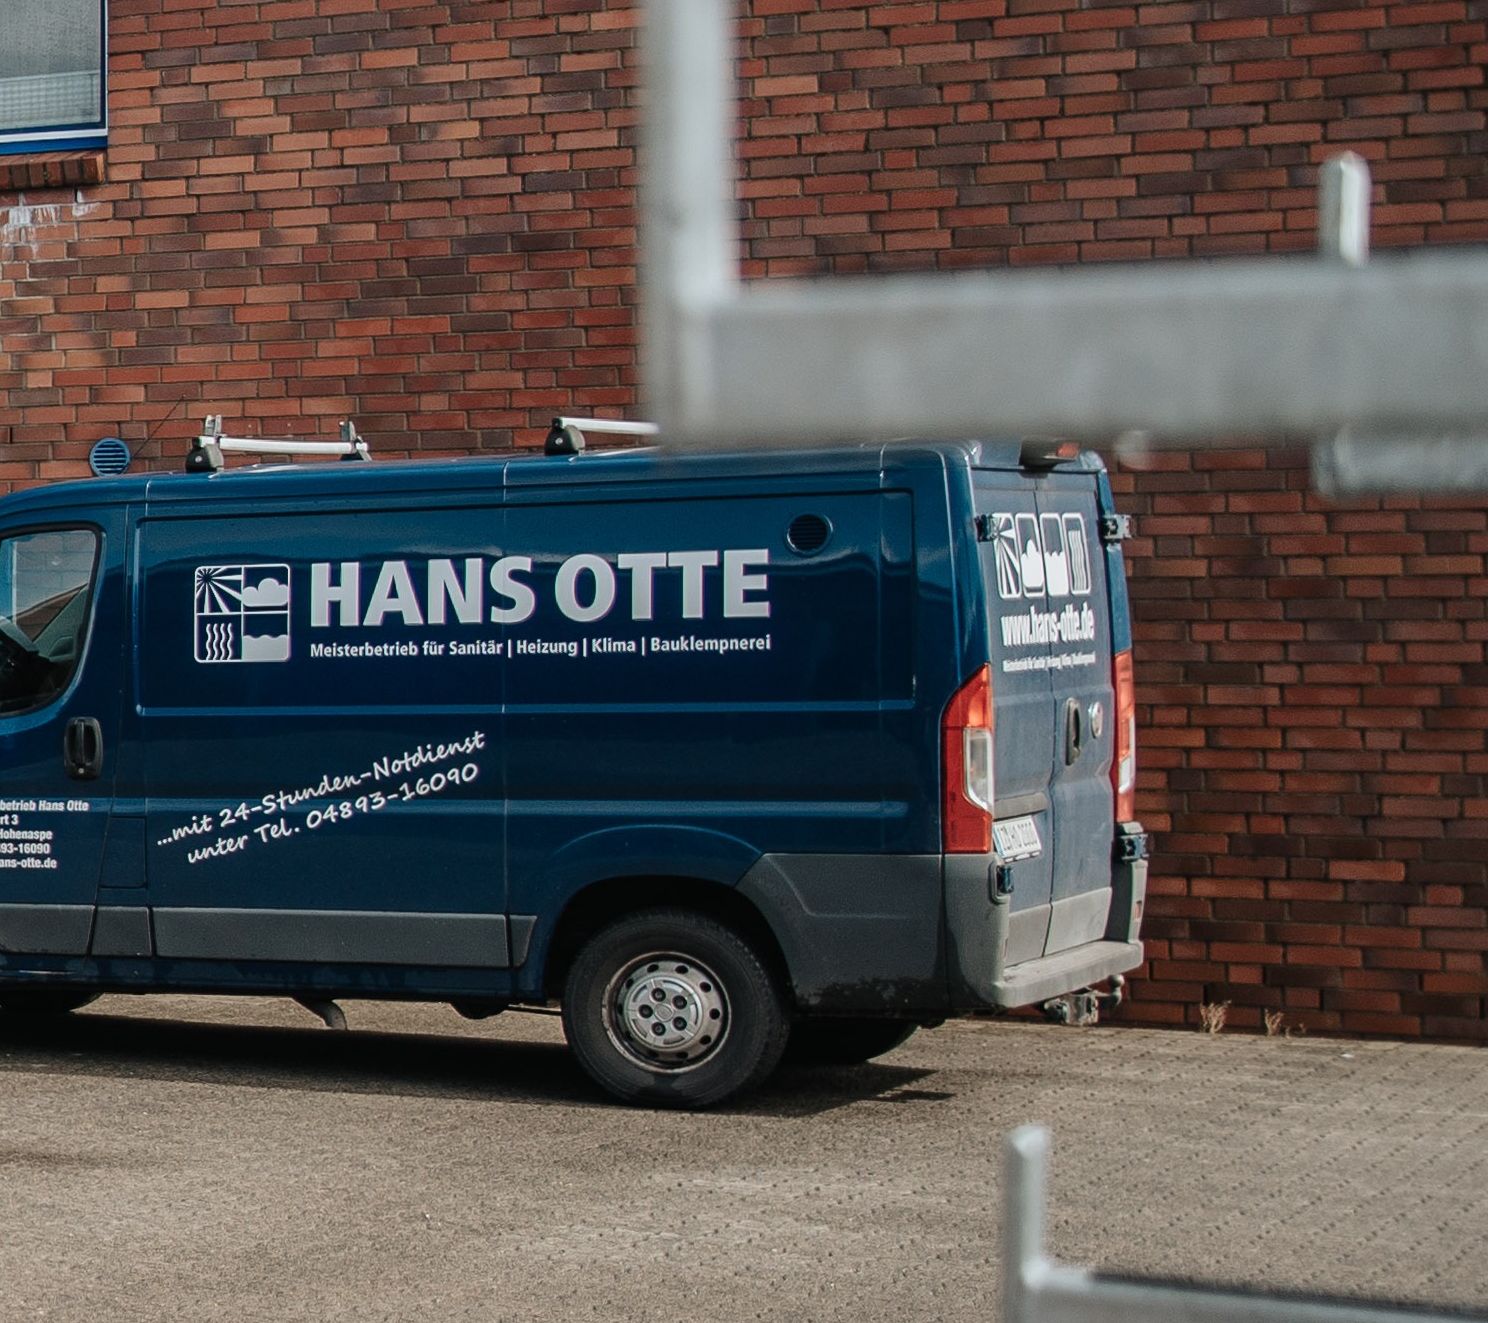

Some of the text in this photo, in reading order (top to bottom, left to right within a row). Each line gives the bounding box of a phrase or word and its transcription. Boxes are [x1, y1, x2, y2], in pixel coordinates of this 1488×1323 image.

[311, 549, 770, 627] HANS OTTE
[311, 642, 418, 657] Meisterbetrieb
[423, 641, 444, 655] für
[450, 640, 502, 654] Sanitär
[517, 639, 577, 656] Heizung
[593, 638, 635, 652] Klima
[651, 634, 770, 654] Bauklempnerei
[1001, 602, 1094, 646] www.hans-otte.de
[220, 731, 485, 828] 24-Stunden-Notdienst
[12, 814, 18, 825] 3
[39, 800, 65, 811] Hans
[67, 800, 89, 811] Otte
[187, 763, 479, 863] unter Tel. 04893-16090
